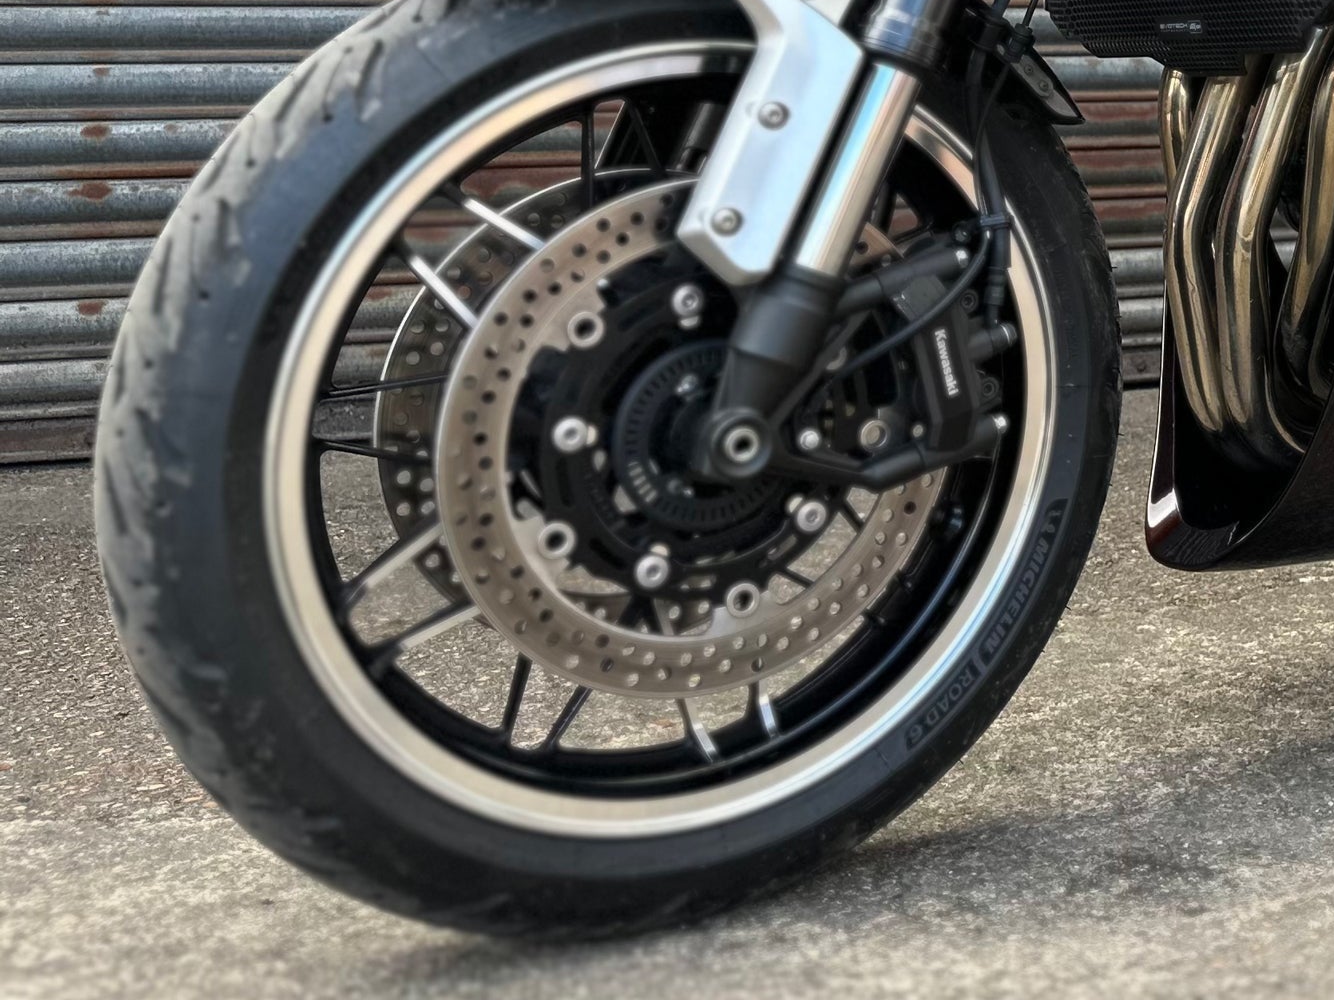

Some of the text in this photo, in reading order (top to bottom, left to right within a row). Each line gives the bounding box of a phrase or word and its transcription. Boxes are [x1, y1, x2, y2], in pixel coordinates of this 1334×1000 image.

[934, 328, 959, 397] Kawasaki
[984, 539, 1049, 655] MICHELIN
[925, 673, 976, 727] ROAD
